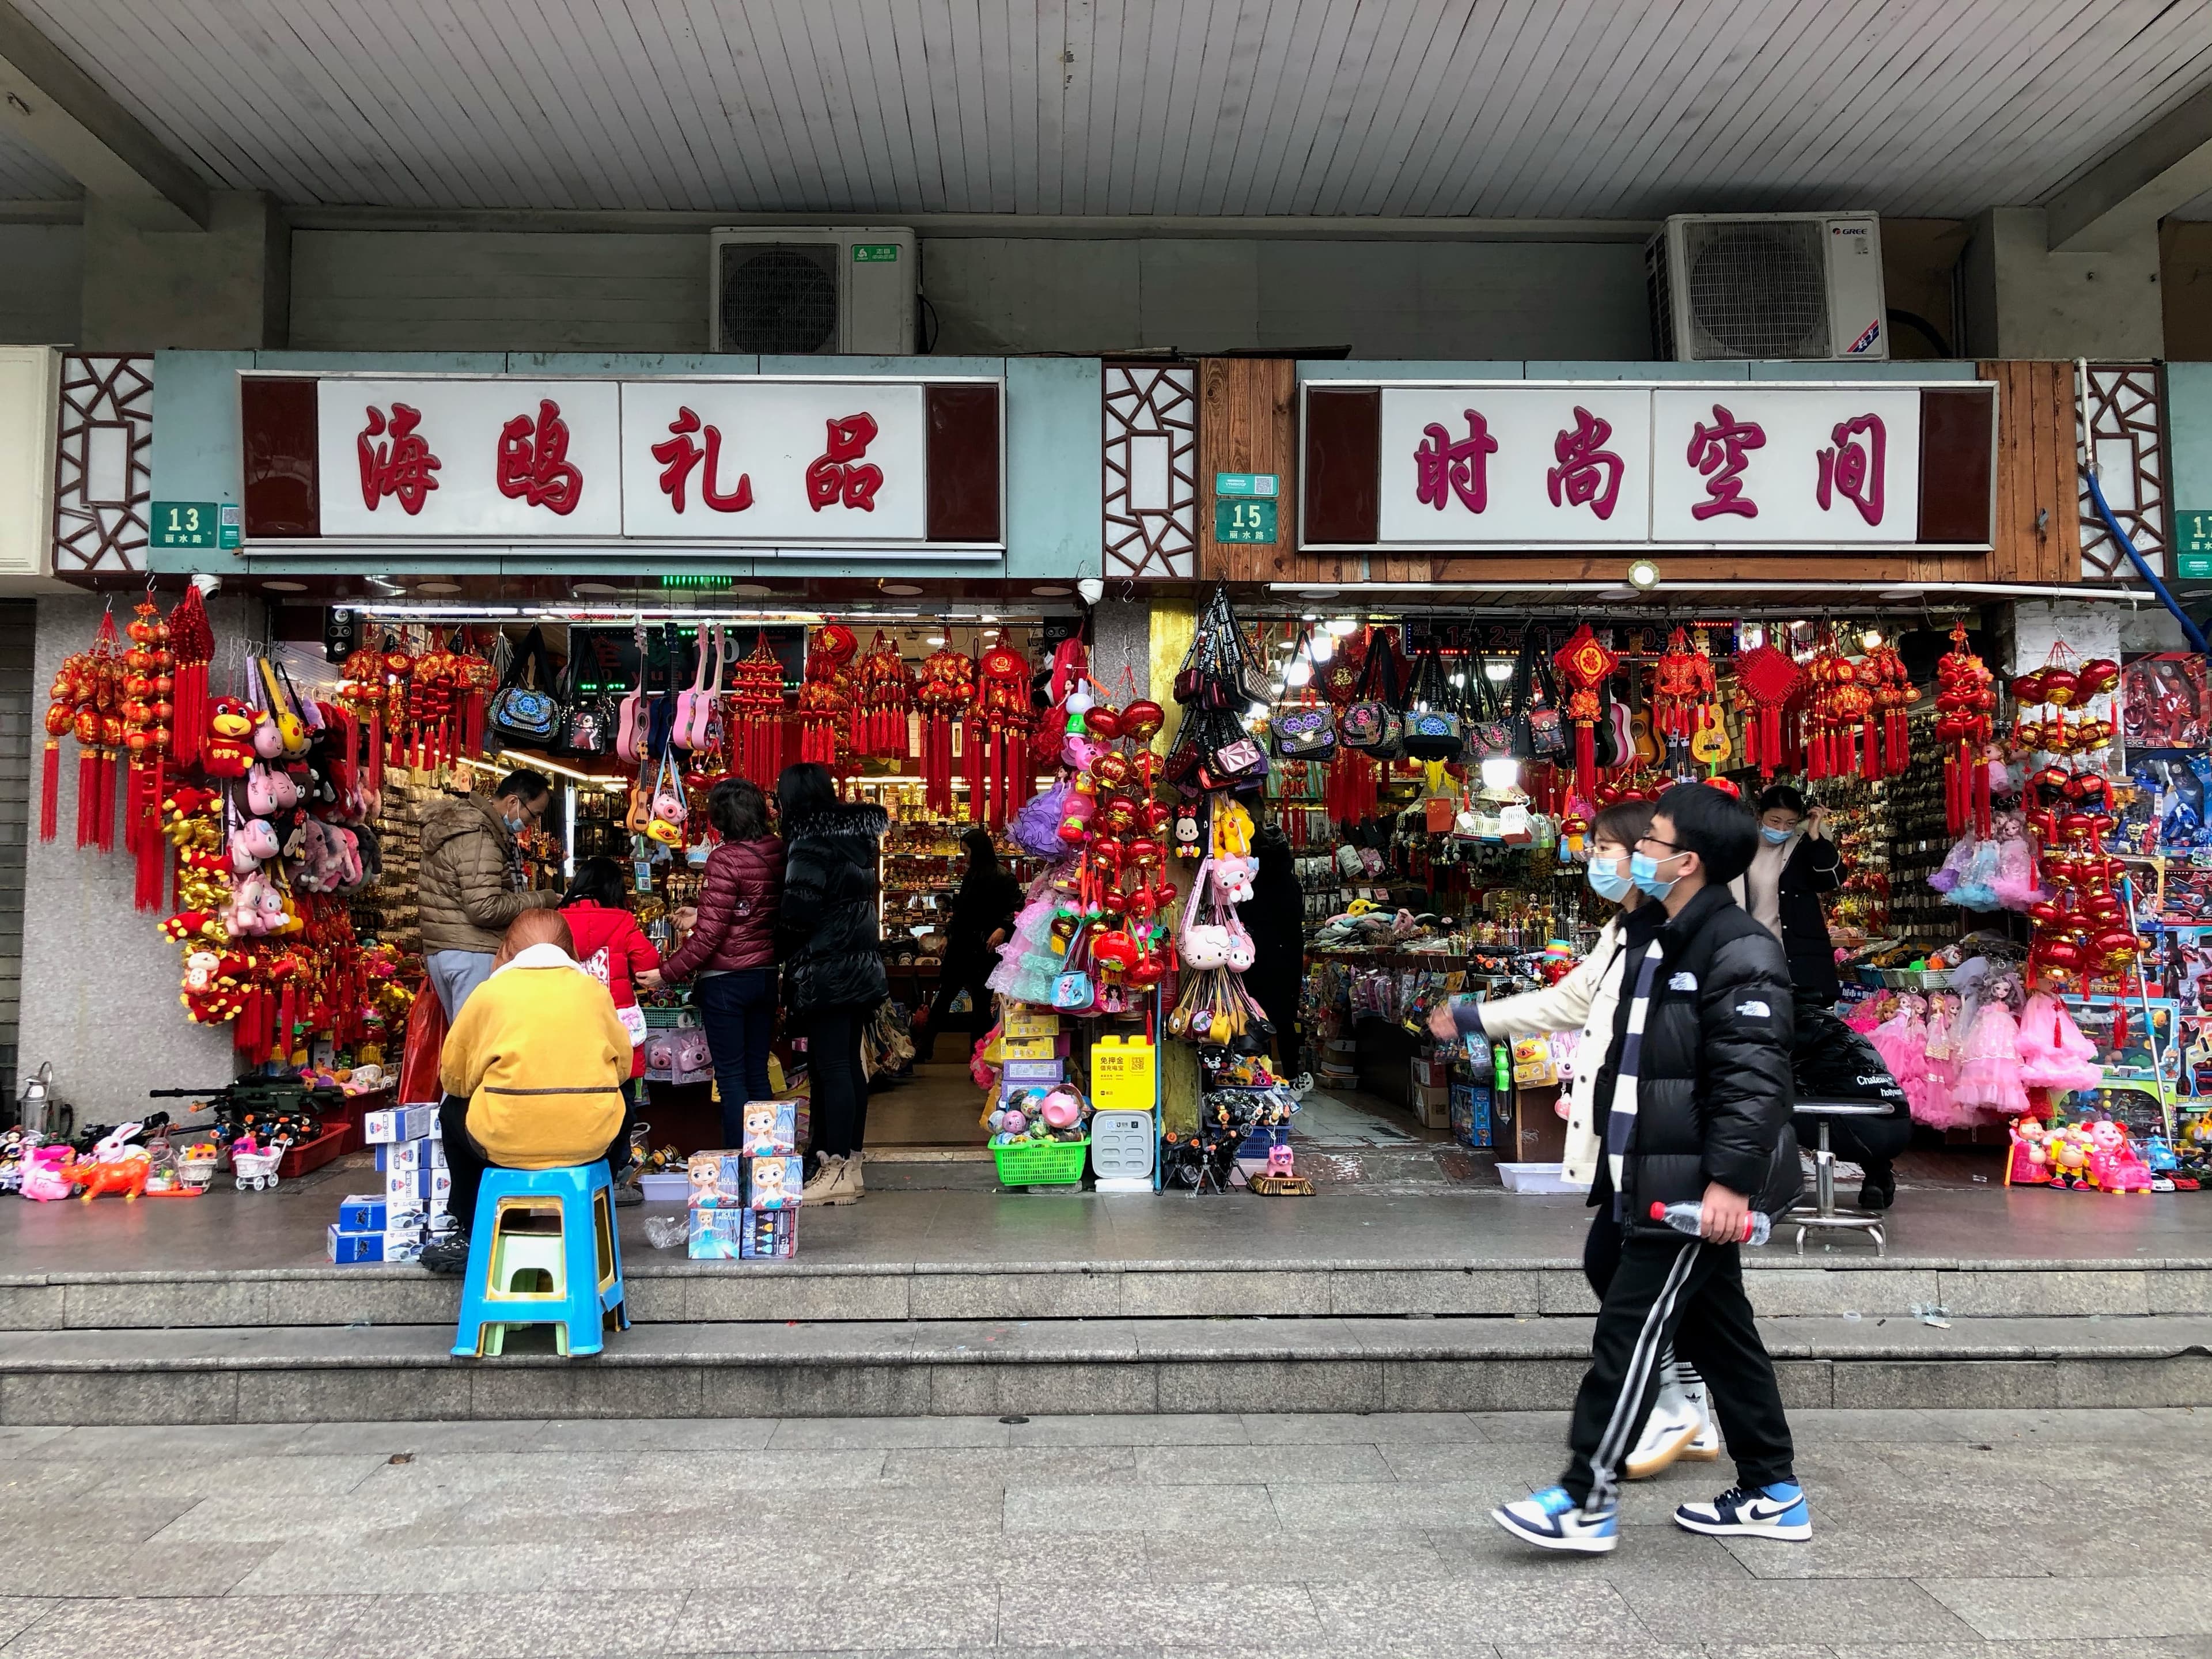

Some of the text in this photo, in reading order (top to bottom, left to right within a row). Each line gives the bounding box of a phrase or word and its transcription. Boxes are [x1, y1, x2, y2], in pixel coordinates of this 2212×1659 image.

[358, 399, 884, 516] 海鸥礼品
[1414, 404, 1887, 527] 时尚空间
[169, 508, 199, 531] 13
[1233, 505, 1262, 528] 15
[165, 535, 202, 544] 丽水路
[1229, 530, 1264, 540] 丽水路
[1100, 1056, 1124, 1065] 免押金
